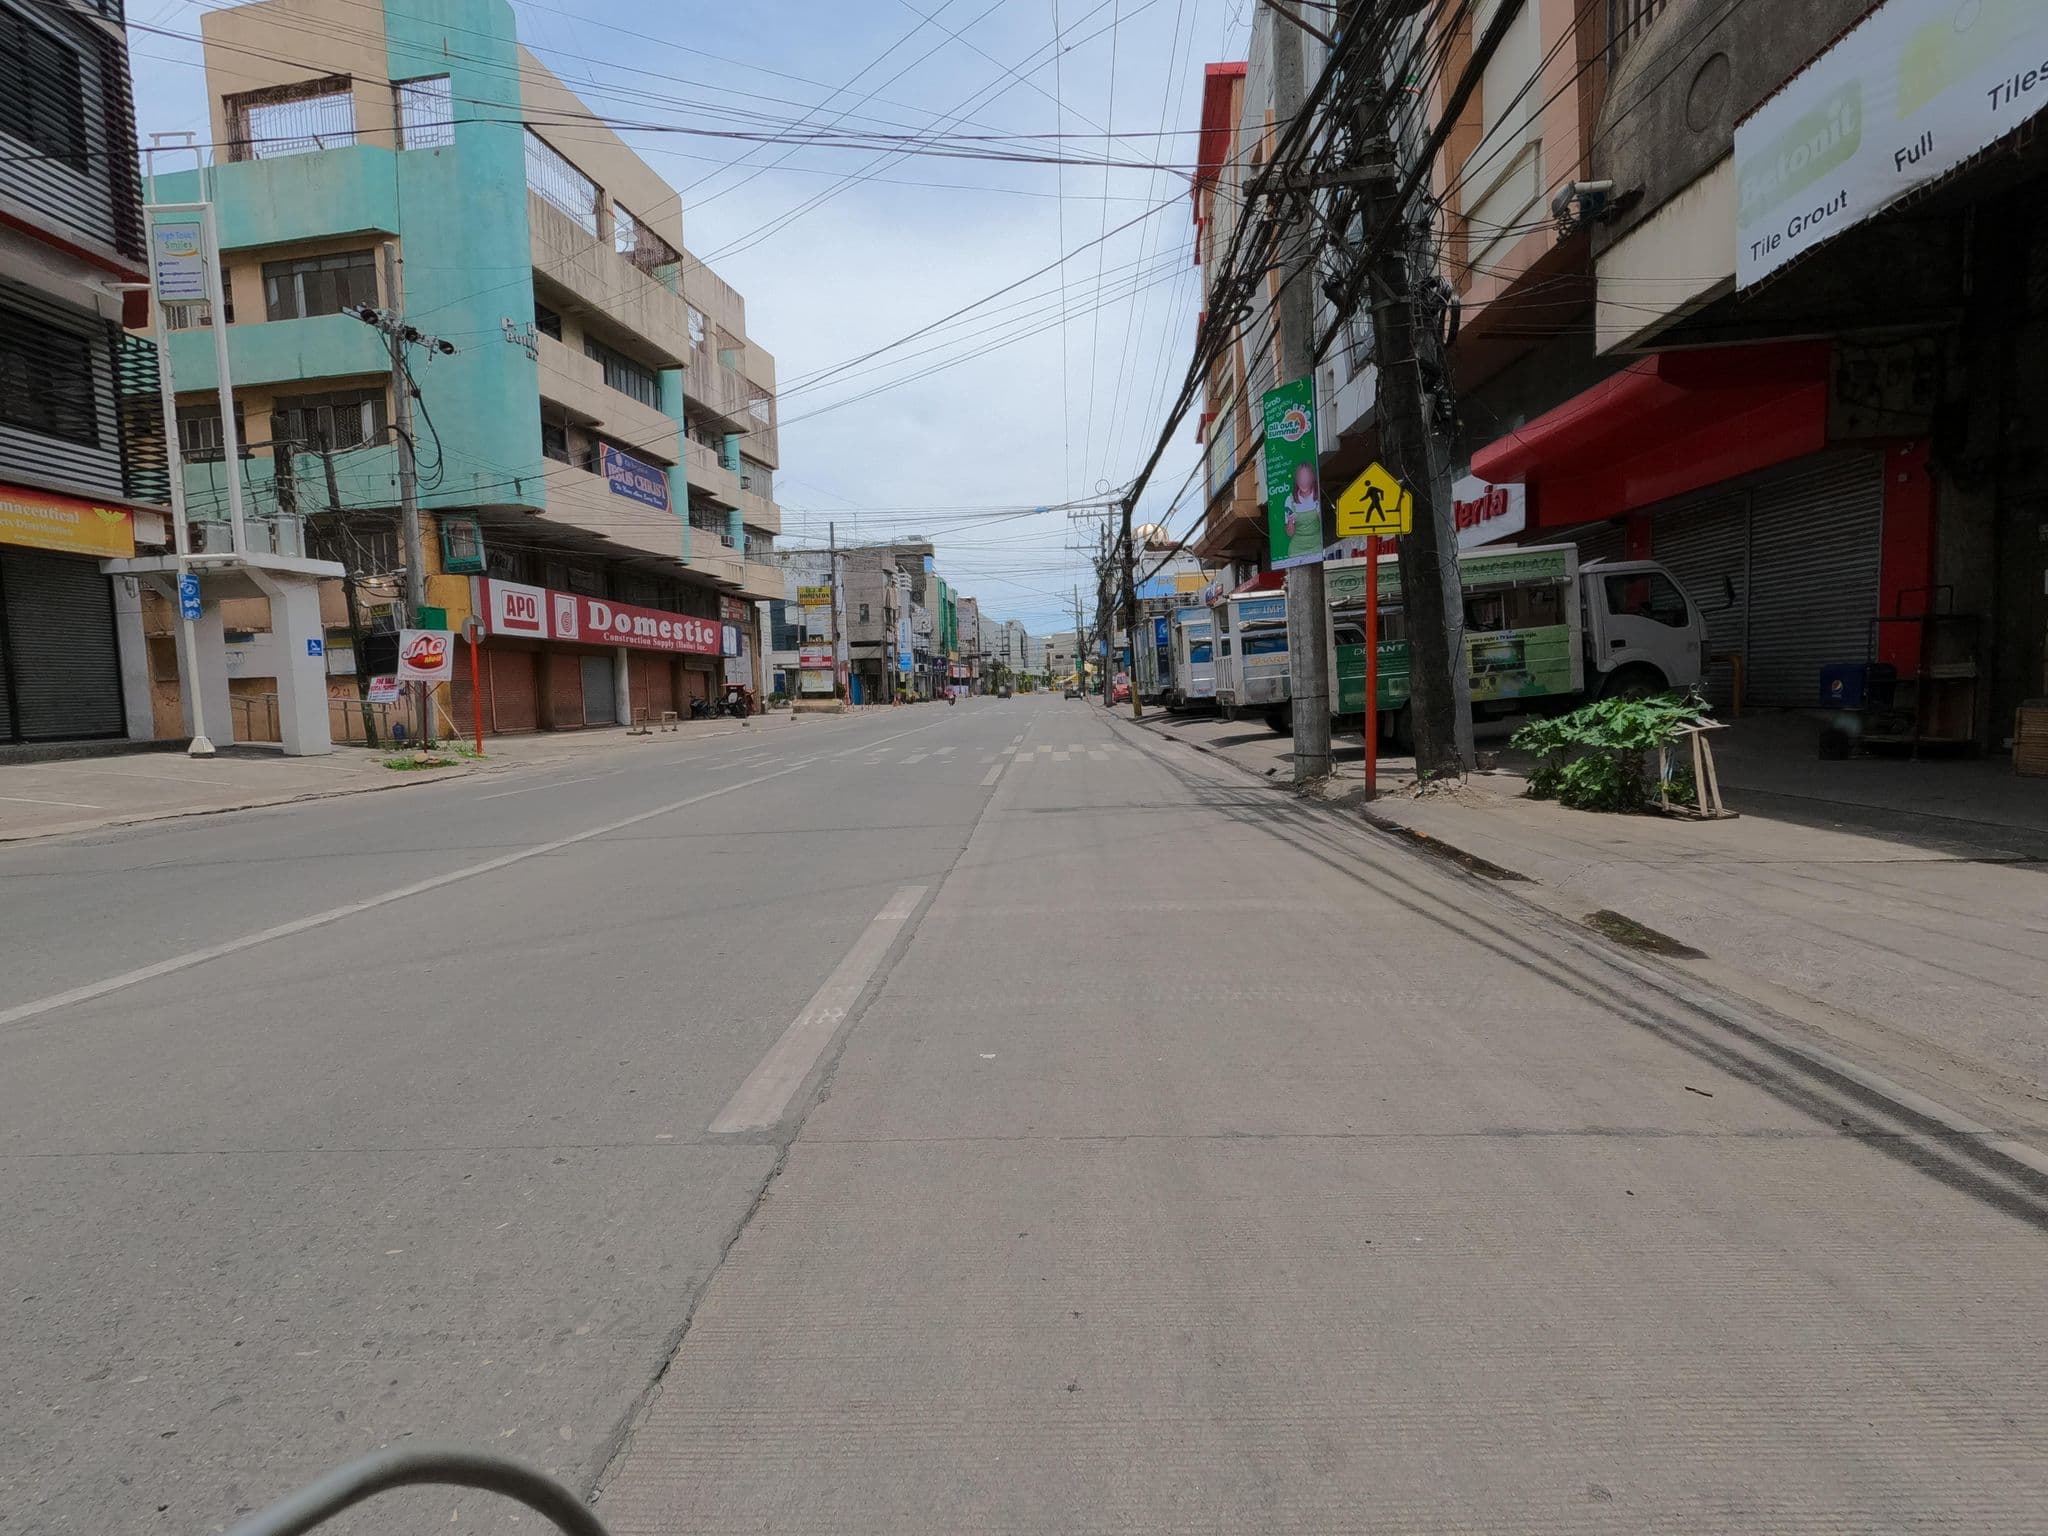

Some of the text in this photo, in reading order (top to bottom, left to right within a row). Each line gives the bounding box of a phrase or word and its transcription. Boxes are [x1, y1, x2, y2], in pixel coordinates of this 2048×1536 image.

[1894, 130, 1933, 172] Full
[1750, 189, 1848, 261] Tile Grout
[164, 240, 193, 249] Smiles
[1264, 397, 1281, 410] Grab
[1268, 427, 1299, 437] summer
[606, 462, 634, 487] JESUS
[634, 475, 666, 500] CHRIST
[1268, 482, 1290, 496] Grab
[505, 594, 536, 619] APO
[587, 600, 714, 644] Domestic
[402, 637, 447, 660] JAQ
[603, 632, 651, 645] Construction
[652, 637, 674, 649] Supply
